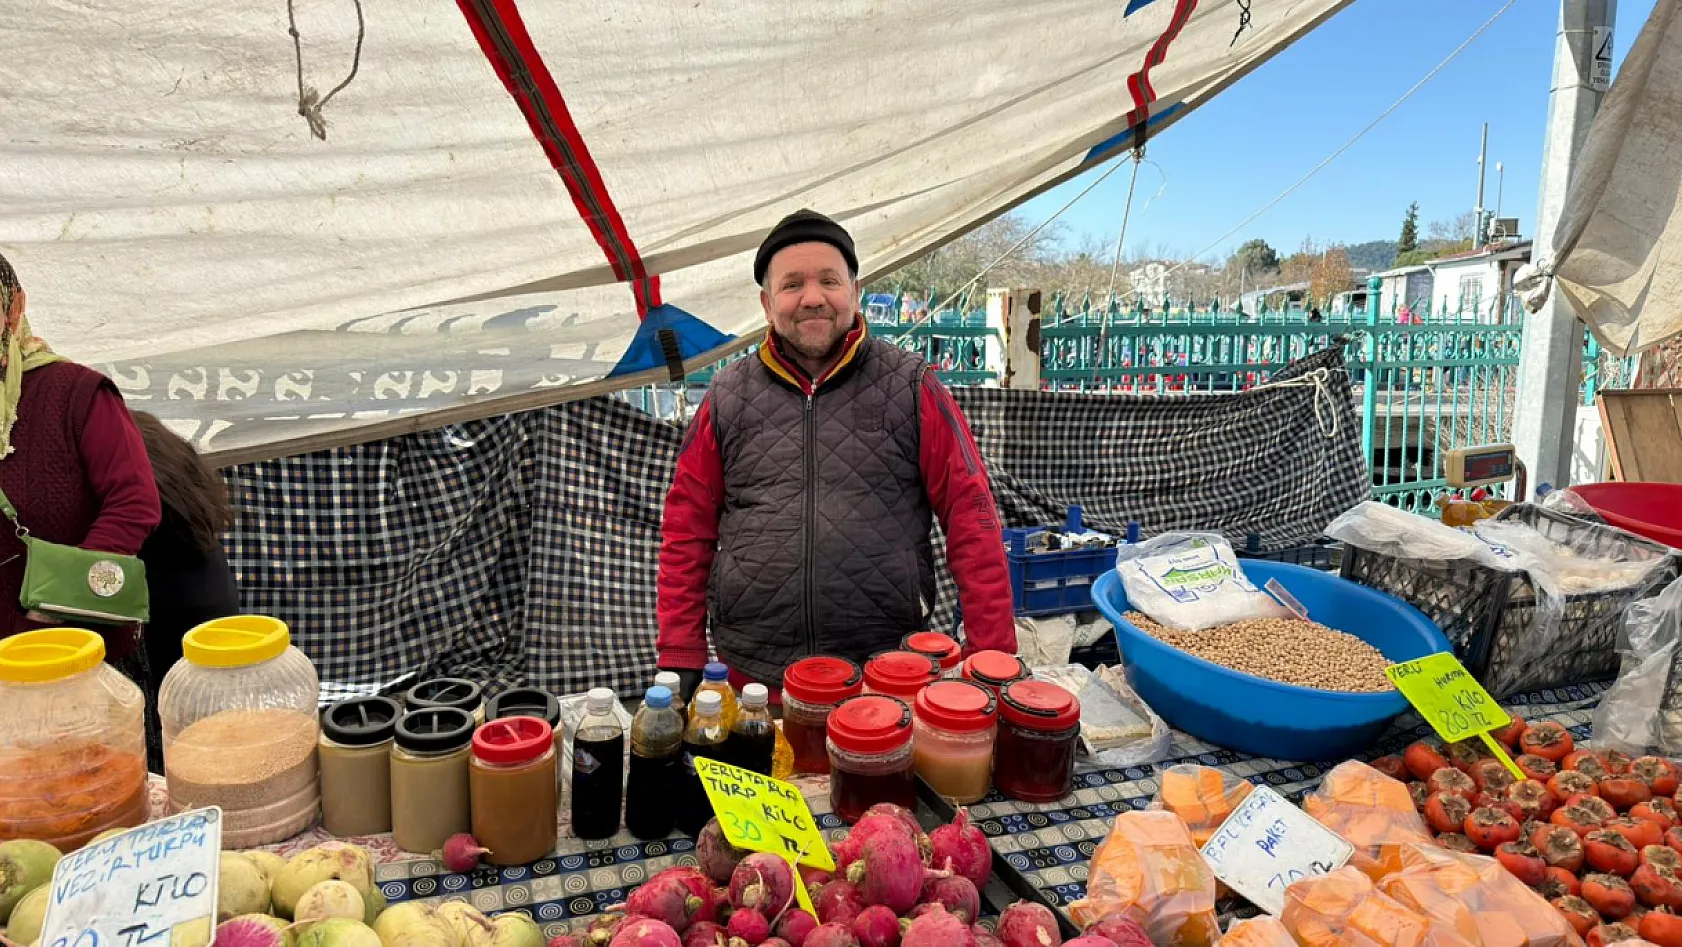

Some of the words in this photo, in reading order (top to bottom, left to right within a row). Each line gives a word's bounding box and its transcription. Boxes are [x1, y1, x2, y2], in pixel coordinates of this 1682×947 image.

[1438, 710, 1469, 735] 80
[725, 811, 762, 841] 30
[1255, 819, 1287, 858] PAKET
